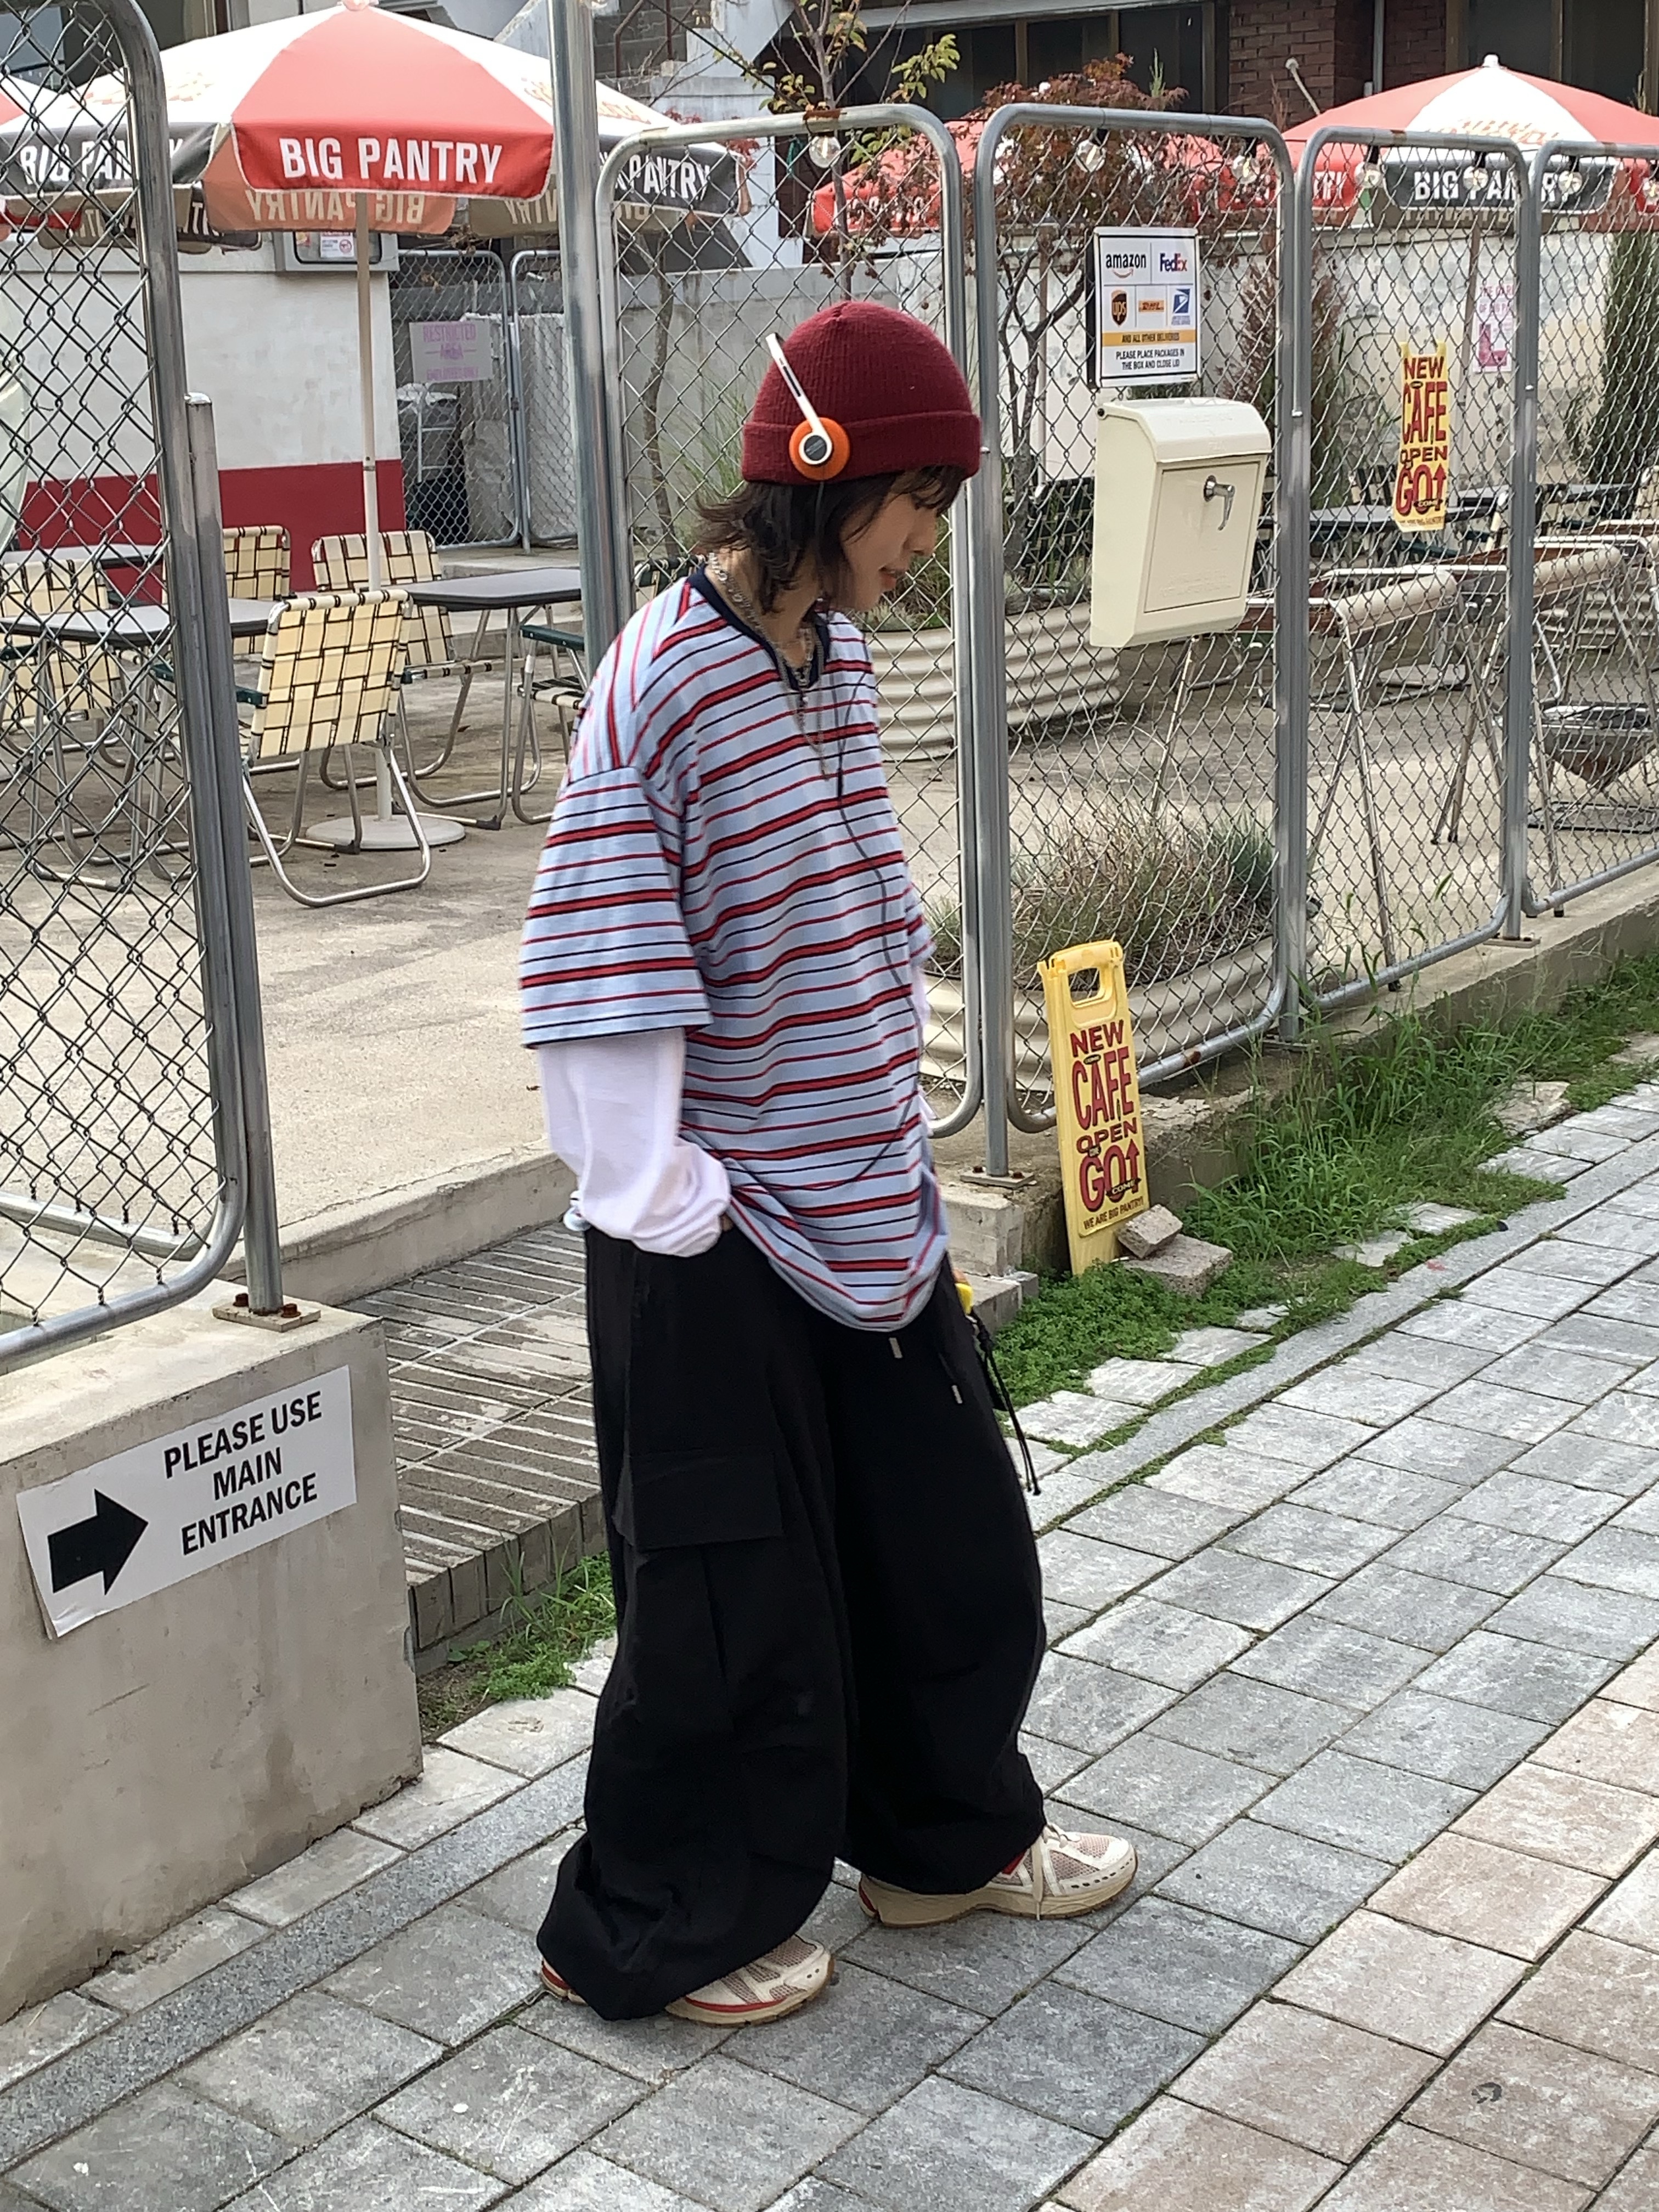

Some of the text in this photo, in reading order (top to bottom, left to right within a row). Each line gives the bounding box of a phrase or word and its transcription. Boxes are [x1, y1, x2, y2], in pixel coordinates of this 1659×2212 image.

[20, 141, 71, 185] BIG
[279, 138, 503, 184] BIG PANTRY
[629, 154, 711, 201] PANTRY
[1414, 170, 1459, 200] BIG
[1105, 253, 1147, 269] amazon
[1160, 252, 1188, 272] FedEx
[1116, 348, 1184, 360] PLEASE PLACE PACKAGES IN
[1122, 334, 1131, 343] AND
[1132, 334, 1141, 343] ALL
[1142, 333, 1156, 342] OTHER
[1122, 360, 1132, 370] THE
[1133, 360, 1144, 370] BOX
[1145, 360, 1155, 369] AND
[1156, 359, 1171, 368] CLOSE
[1403, 356, 1444, 380] NEW
[1402, 381, 1448, 445] CAFE
[1400, 445, 1448, 465] OPEN
[1070, 1019, 1124, 1058] NEW
[1071, 1046, 1135, 1131] CAFE
[1076, 1117, 1138, 1154] OPEN
[1084, 1216, 1095, 1229] WE
[1095, 1211, 1107, 1224] ARE
[1108, 1207, 1119, 1220] BIG
[164, 1391, 323, 1479] PLEASE USE
[212, 1447, 283, 1500] MAIN
[181, 1472, 318, 1556] ENTRANCE
